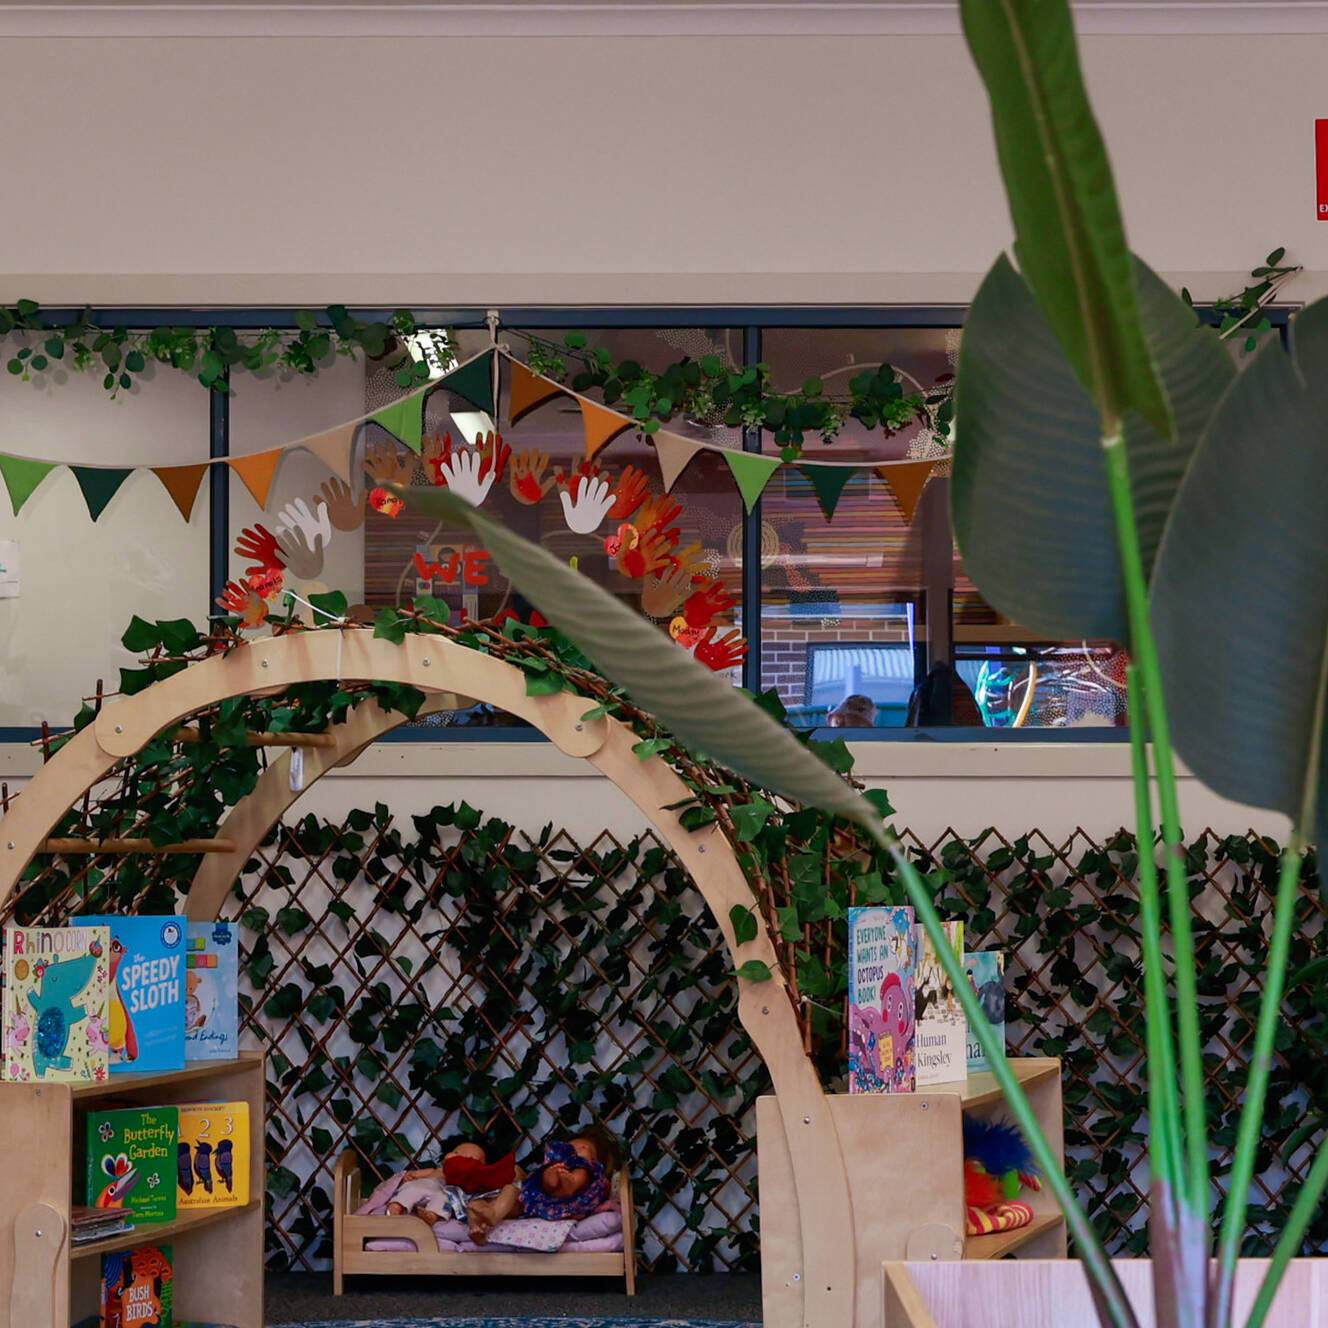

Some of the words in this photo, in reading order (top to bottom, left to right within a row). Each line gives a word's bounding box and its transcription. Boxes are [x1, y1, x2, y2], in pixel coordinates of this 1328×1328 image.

[415, 551, 490, 586] WE
[857, 925, 886, 945] EVERYONE
[857, 947, 877, 963] WANTS
[878, 946, 889, 961] AN
[122, 954, 181, 992] SPEEDY
[857, 965, 884, 984] OCTOPUS
[130, 982, 180, 1014] SLOTH
[916, 1033, 947, 1048] Human
[917, 1050, 952, 1068] Kingsley
[141, 1113, 158, 1126] The
[199, 1118, 213, 1138] 2
[222, 1115, 234, 1136] 3
[123, 1123, 175, 1145] Butterfly
[129, 1143, 168, 1161] Garden
[178, 1197, 211, 1205] Australian
[213, 1194, 239, 1203] Animals
[128, 1284, 151, 1302] BUSH
[126, 1301, 154, 1321] BIRDS
